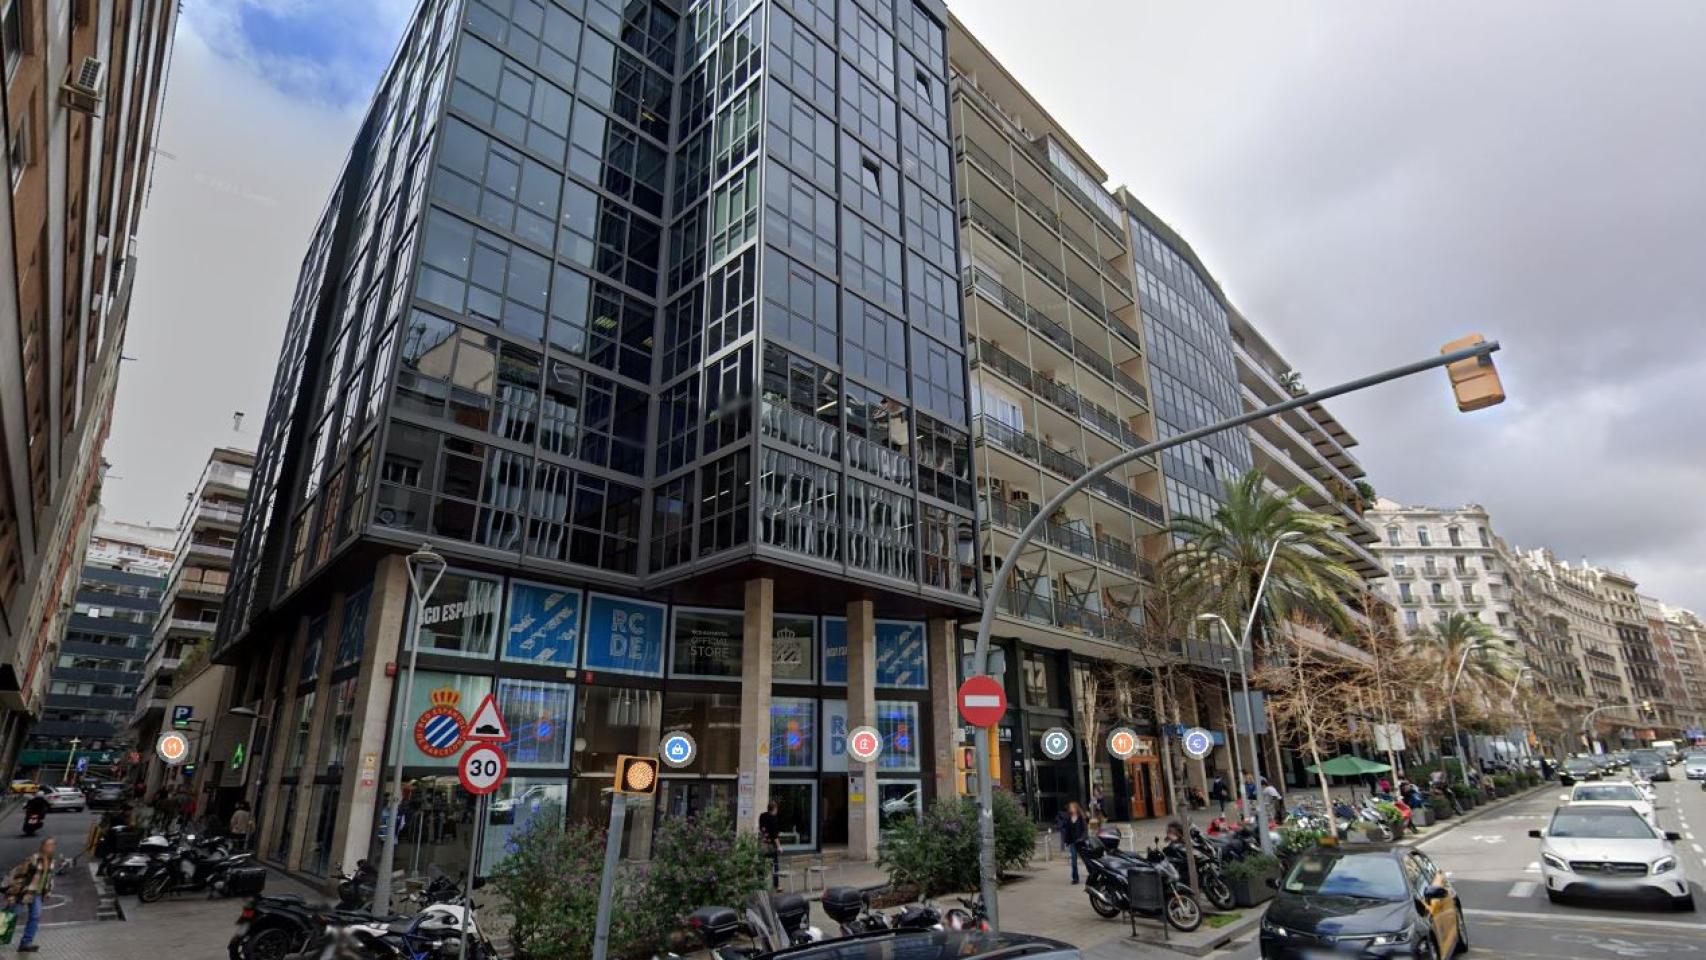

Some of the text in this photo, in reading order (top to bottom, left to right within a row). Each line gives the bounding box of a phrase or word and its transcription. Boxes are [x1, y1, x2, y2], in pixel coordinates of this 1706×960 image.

[422, 606, 441, 626] CD
[612, 608, 645, 635] RC
[610, 633, 642, 660] DE
[690, 646, 729, 658] STORE
[175, 707, 188, 719] P
[470, 759, 497, 777] 30
